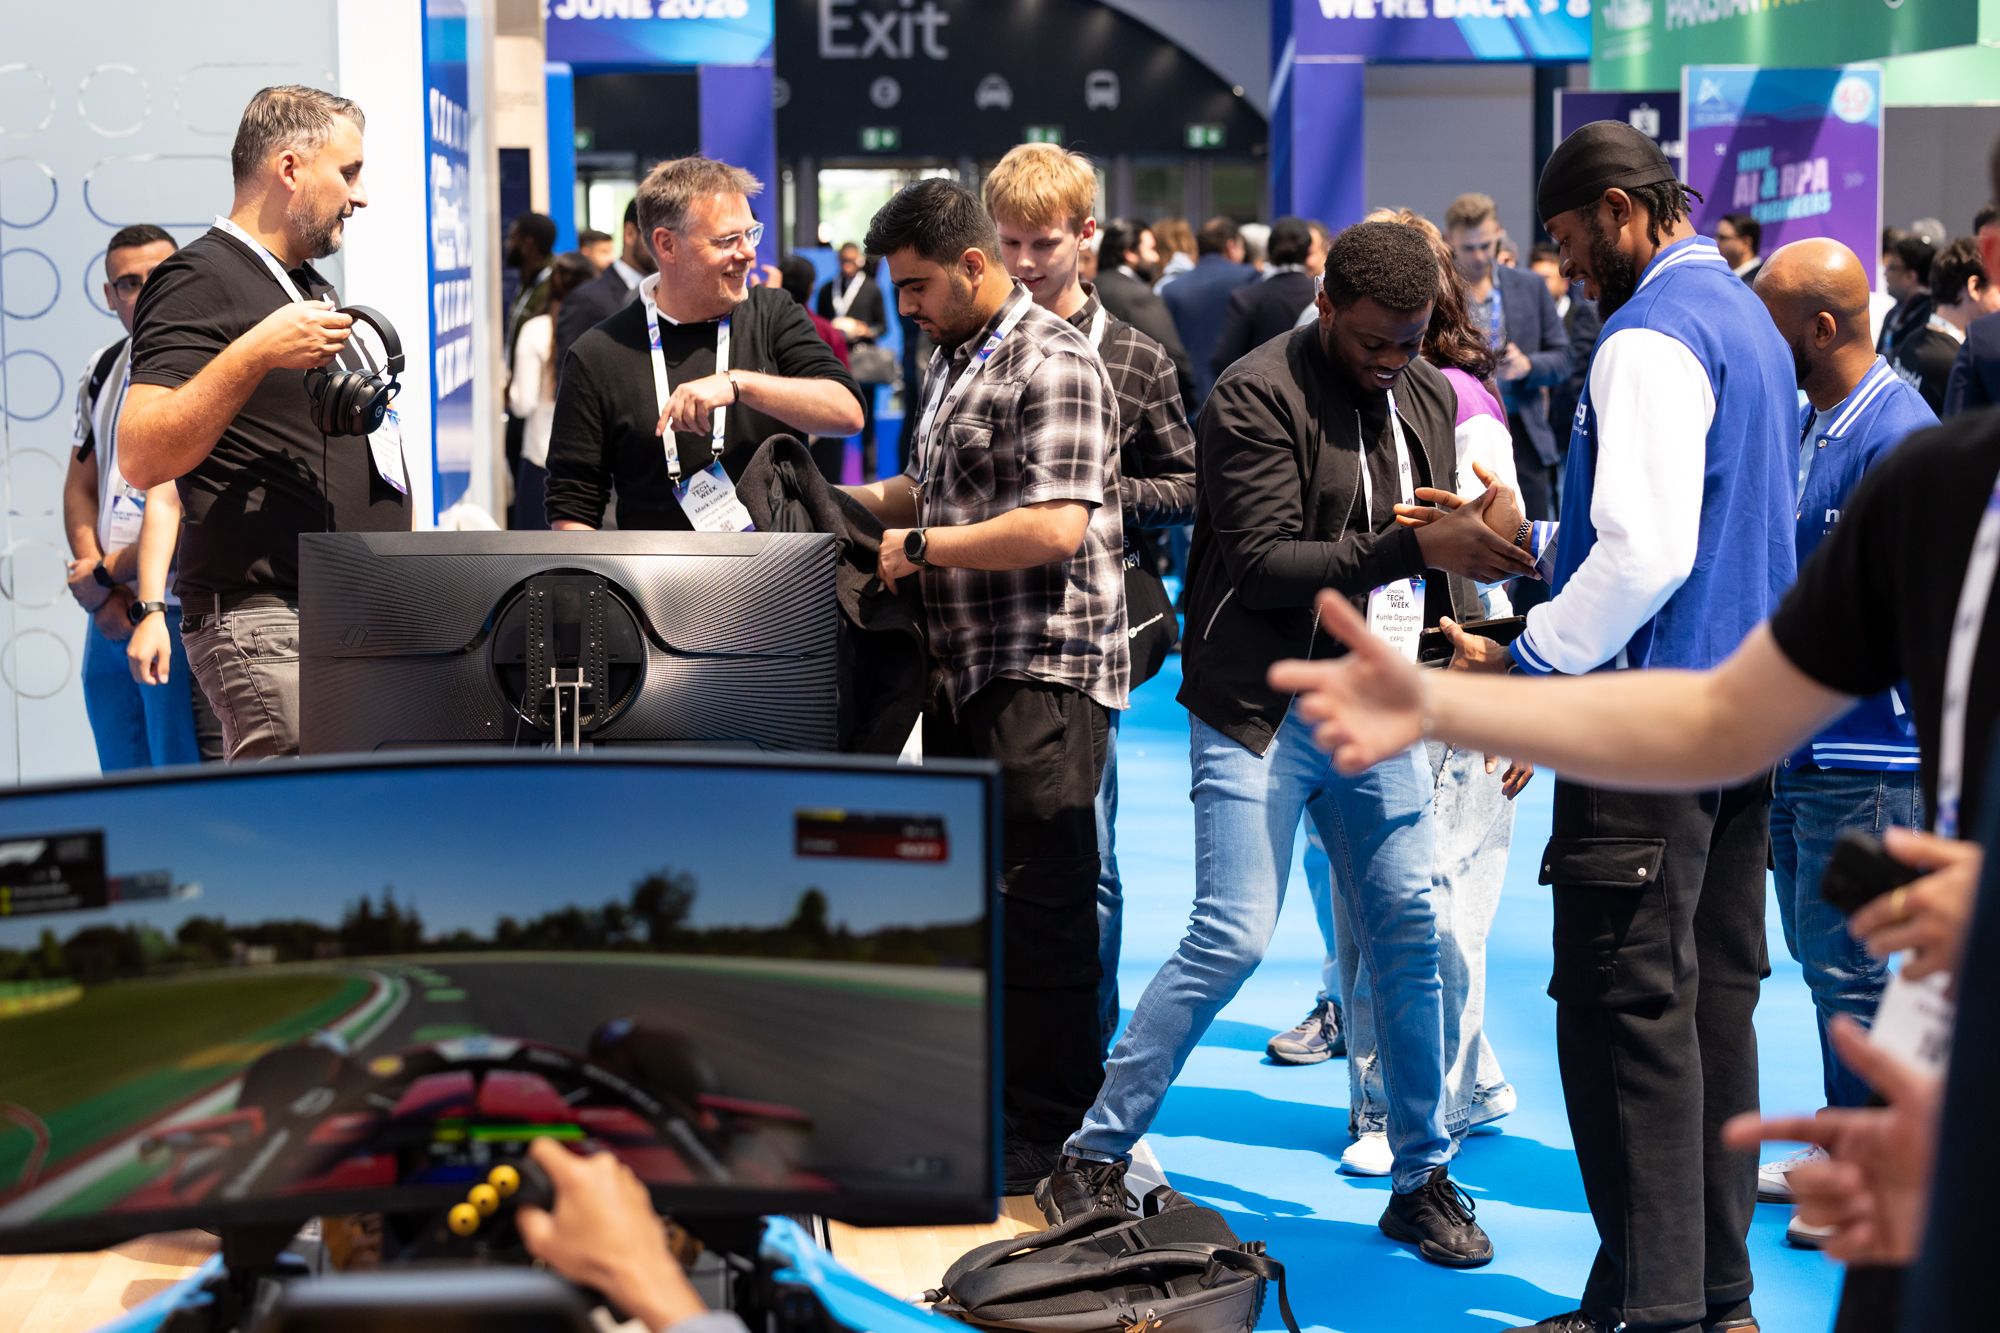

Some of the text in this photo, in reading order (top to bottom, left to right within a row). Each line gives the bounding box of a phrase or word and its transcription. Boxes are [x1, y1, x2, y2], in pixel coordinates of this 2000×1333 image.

[555, 0, 654, 20] JUNE
[1318, 0, 1429, 19] WERE
[1433, 0, 1532, 19] BACK
[818, 0, 950, 60] Exit
[1732, 172, 1760, 209] AI
[1780, 157, 1829, 198] RPA
[692, 484, 710, 497] TECH
[700, 485, 717, 499] WEEK
[1376, 613, 1392, 621] Kunle
